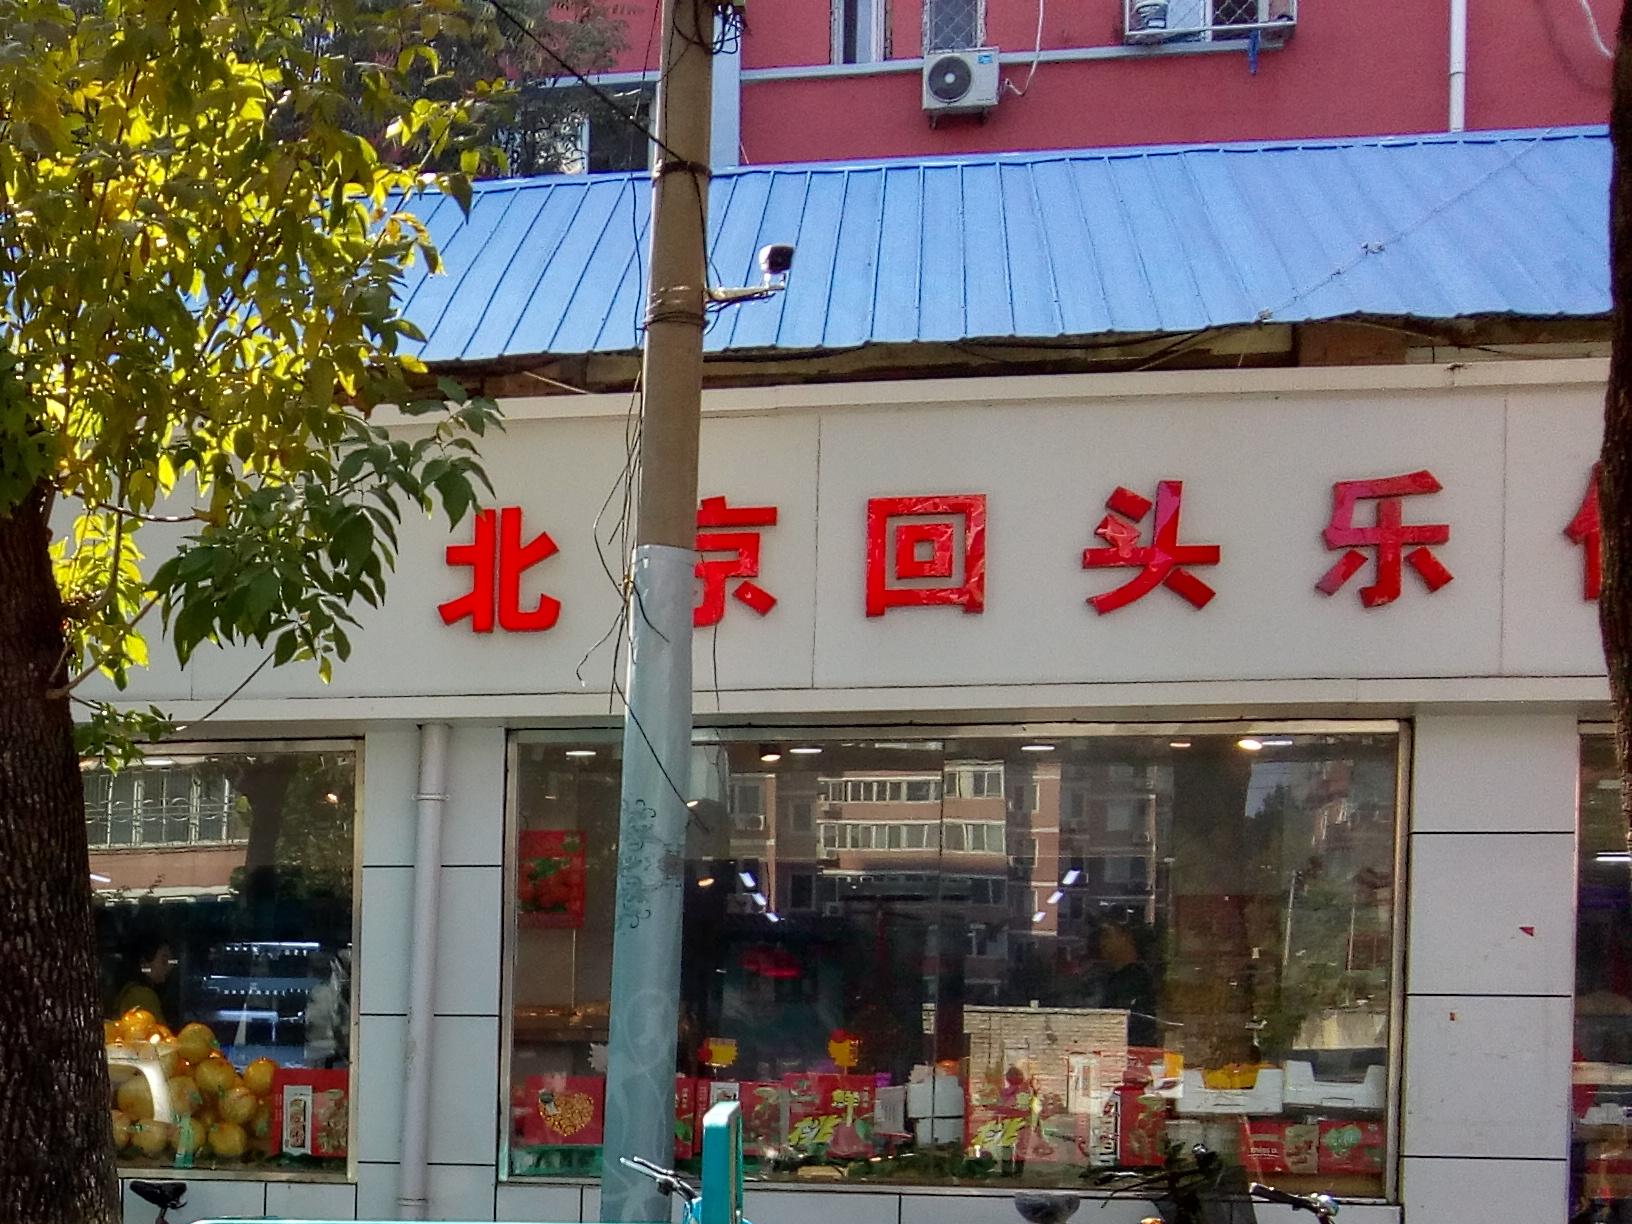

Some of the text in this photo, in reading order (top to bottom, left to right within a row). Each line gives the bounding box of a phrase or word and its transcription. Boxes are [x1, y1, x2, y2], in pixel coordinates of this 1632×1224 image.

[438, 460, 1602, 633] 北京回头乐
